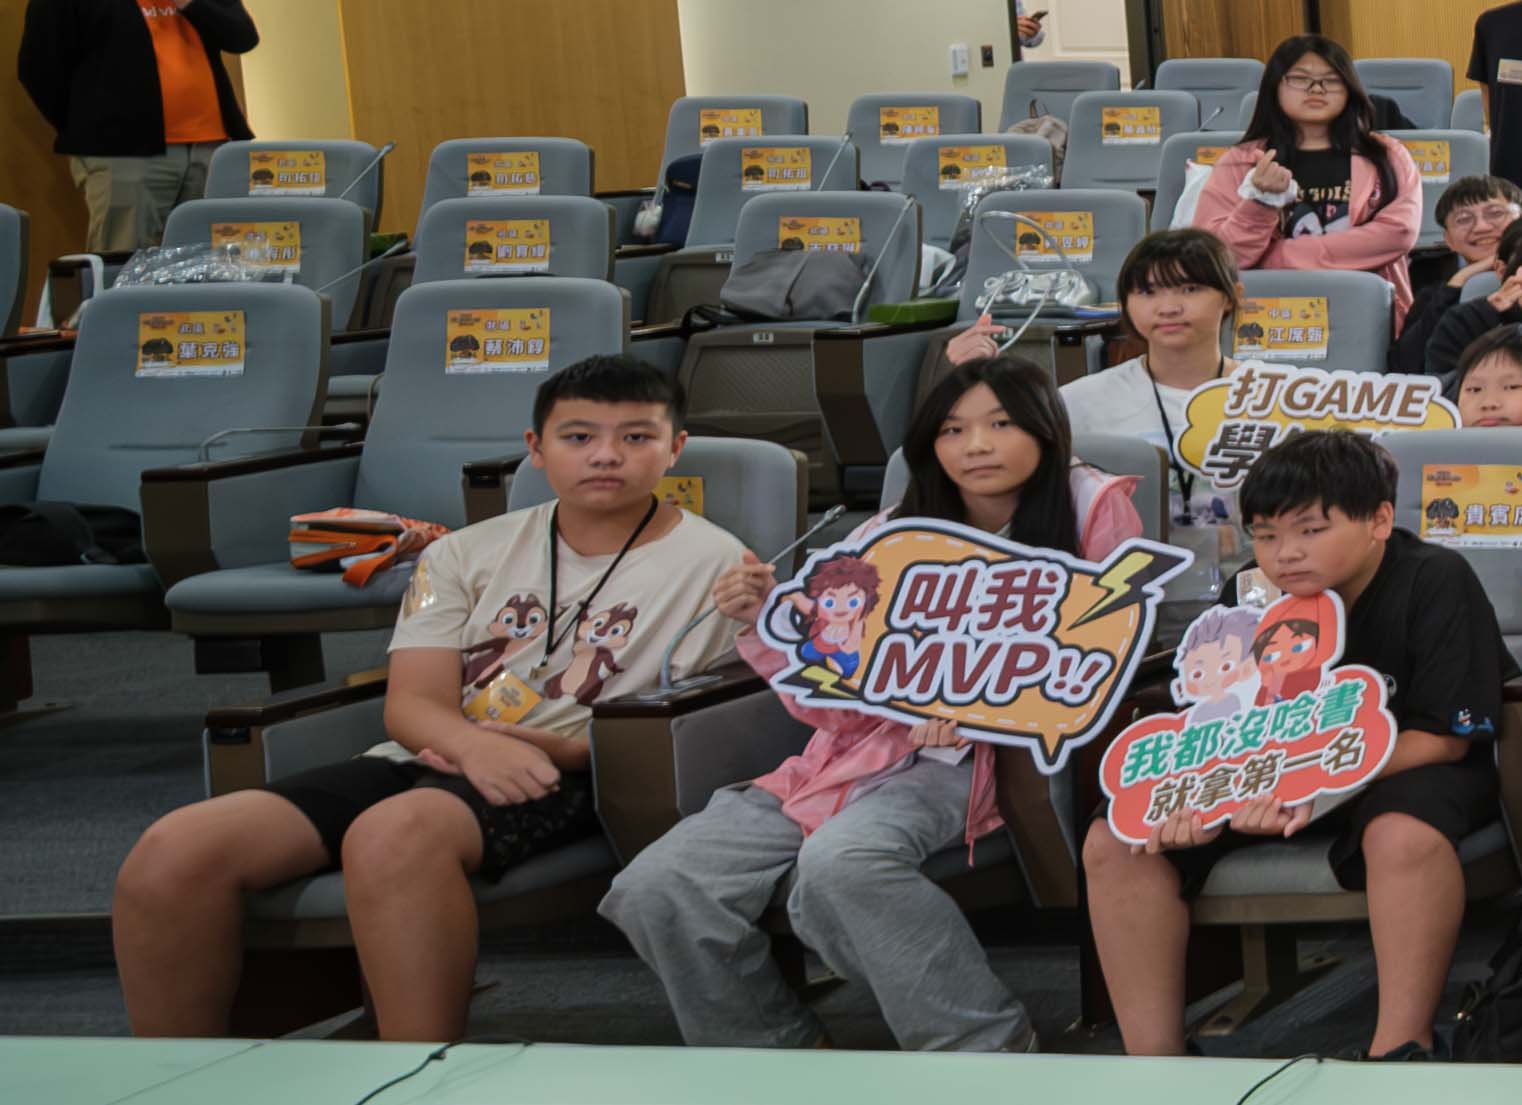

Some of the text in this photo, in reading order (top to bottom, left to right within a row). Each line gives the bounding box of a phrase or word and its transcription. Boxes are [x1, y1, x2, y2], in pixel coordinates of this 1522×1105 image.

[900, 567, 1058, 633] 叫我
[872, 641, 1102, 696] MVP!!
[1121, 679, 1367, 784] 我都沒唸書
[1146, 730, 1366, 822] 就拿第一名
